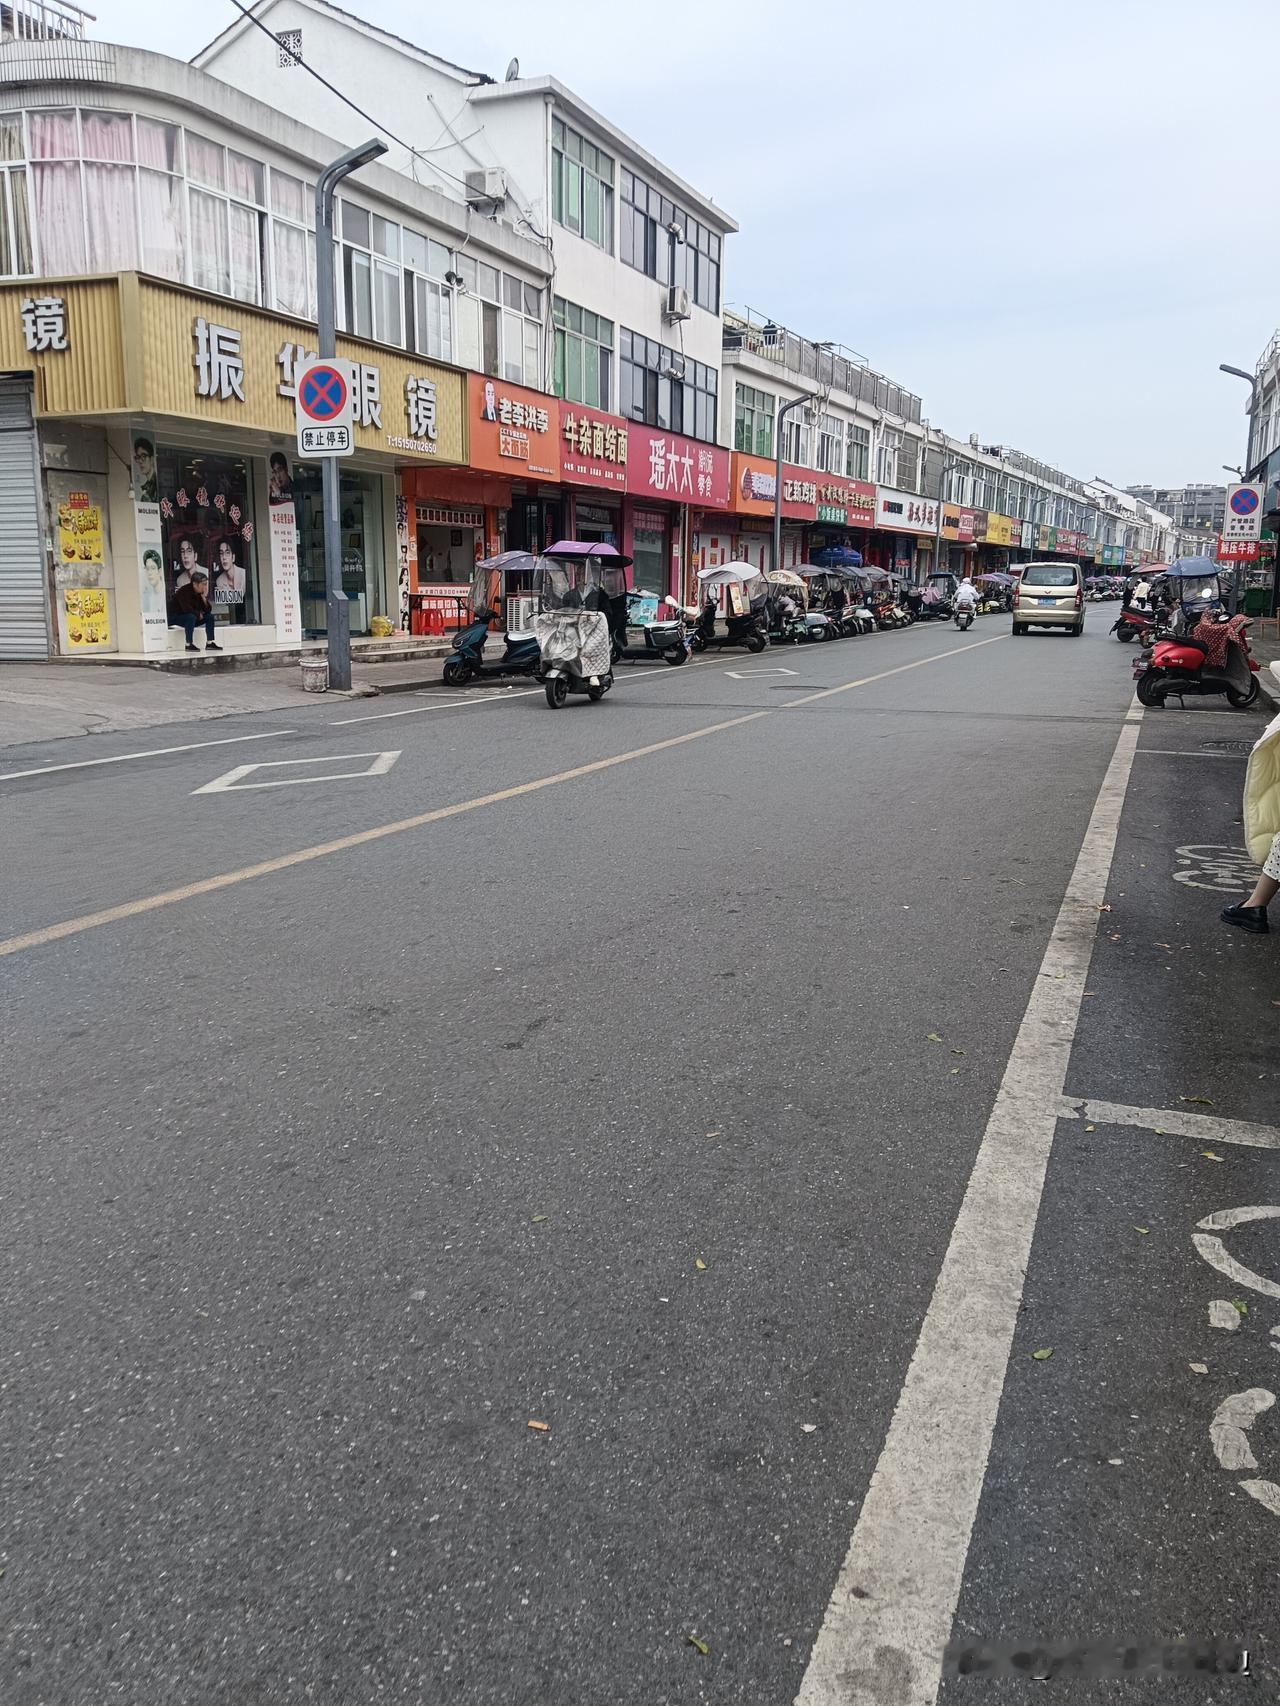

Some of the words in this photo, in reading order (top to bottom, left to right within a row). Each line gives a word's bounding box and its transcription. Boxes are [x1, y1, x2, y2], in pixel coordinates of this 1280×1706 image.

[21, 296, 68, 351] 镜
[304, 430, 347, 447] 禁止停车
[138, 507, 159, 515] MOLSION
[214, 590, 244, 604] MOLSION
